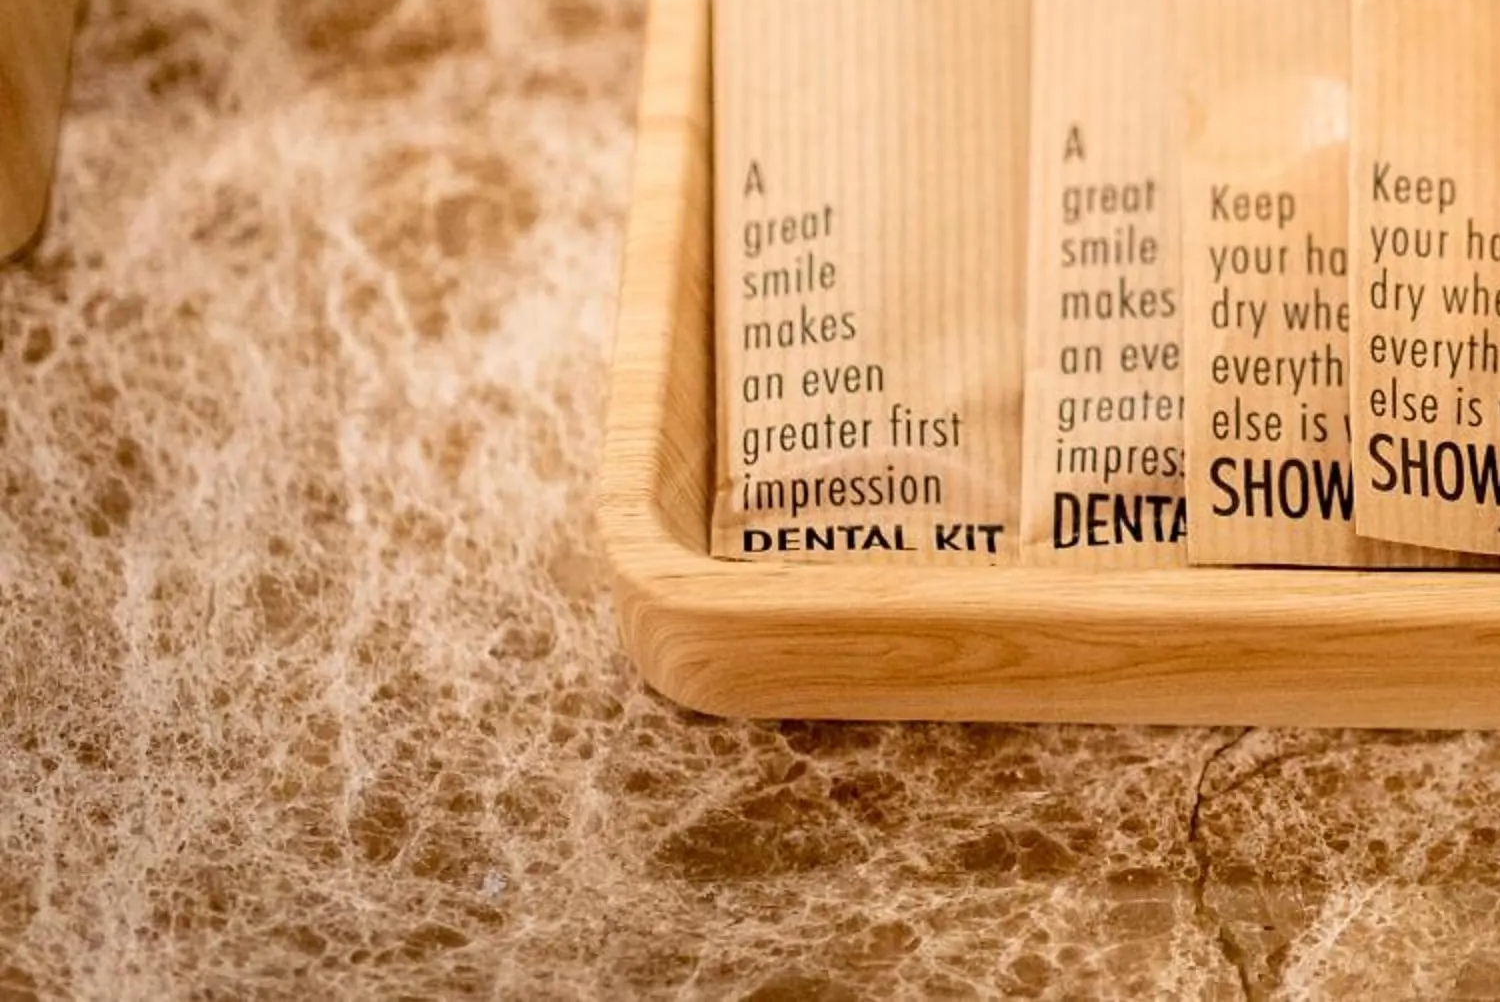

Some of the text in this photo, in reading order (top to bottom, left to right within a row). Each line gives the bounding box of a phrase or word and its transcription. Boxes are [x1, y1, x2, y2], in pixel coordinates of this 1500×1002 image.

[1063, 123, 1086, 164] A
[744, 159, 765, 196] A
[1063, 178, 1156, 221] great
[1371, 161, 1456, 214] Keep
[1210, 183, 1296, 229] Keep
[743, 204, 835, 258] great
[1061, 224, 1158, 268] smile
[1370, 225, 1449, 264] your
[742, 253, 836, 300] smile
[1209, 243, 1288, 283] your
[1061, 276, 1176, 320] makes
[1211, 287, 1267, 339] dry
[1370, 267, 1424, 321] dry
[743, 305, 857, 351] makes
[1060, 344, 1100, 375] an
[1212, 344, 1343, 395] everyth
[743, 363, 884, 403] an even
[1370, 376, 1438, 423] else
[1456, 386, 1483, 428] is
[743, 404, 963, 465] greater first
[1212, 396, 1282, 442] else
[1300, 403, 1328, 443] is
[743, 465, 942, 517] impression
[1209, 457, 1354, 521] SHOW
[743, 523, 1005, 554] DENTAL KIT
